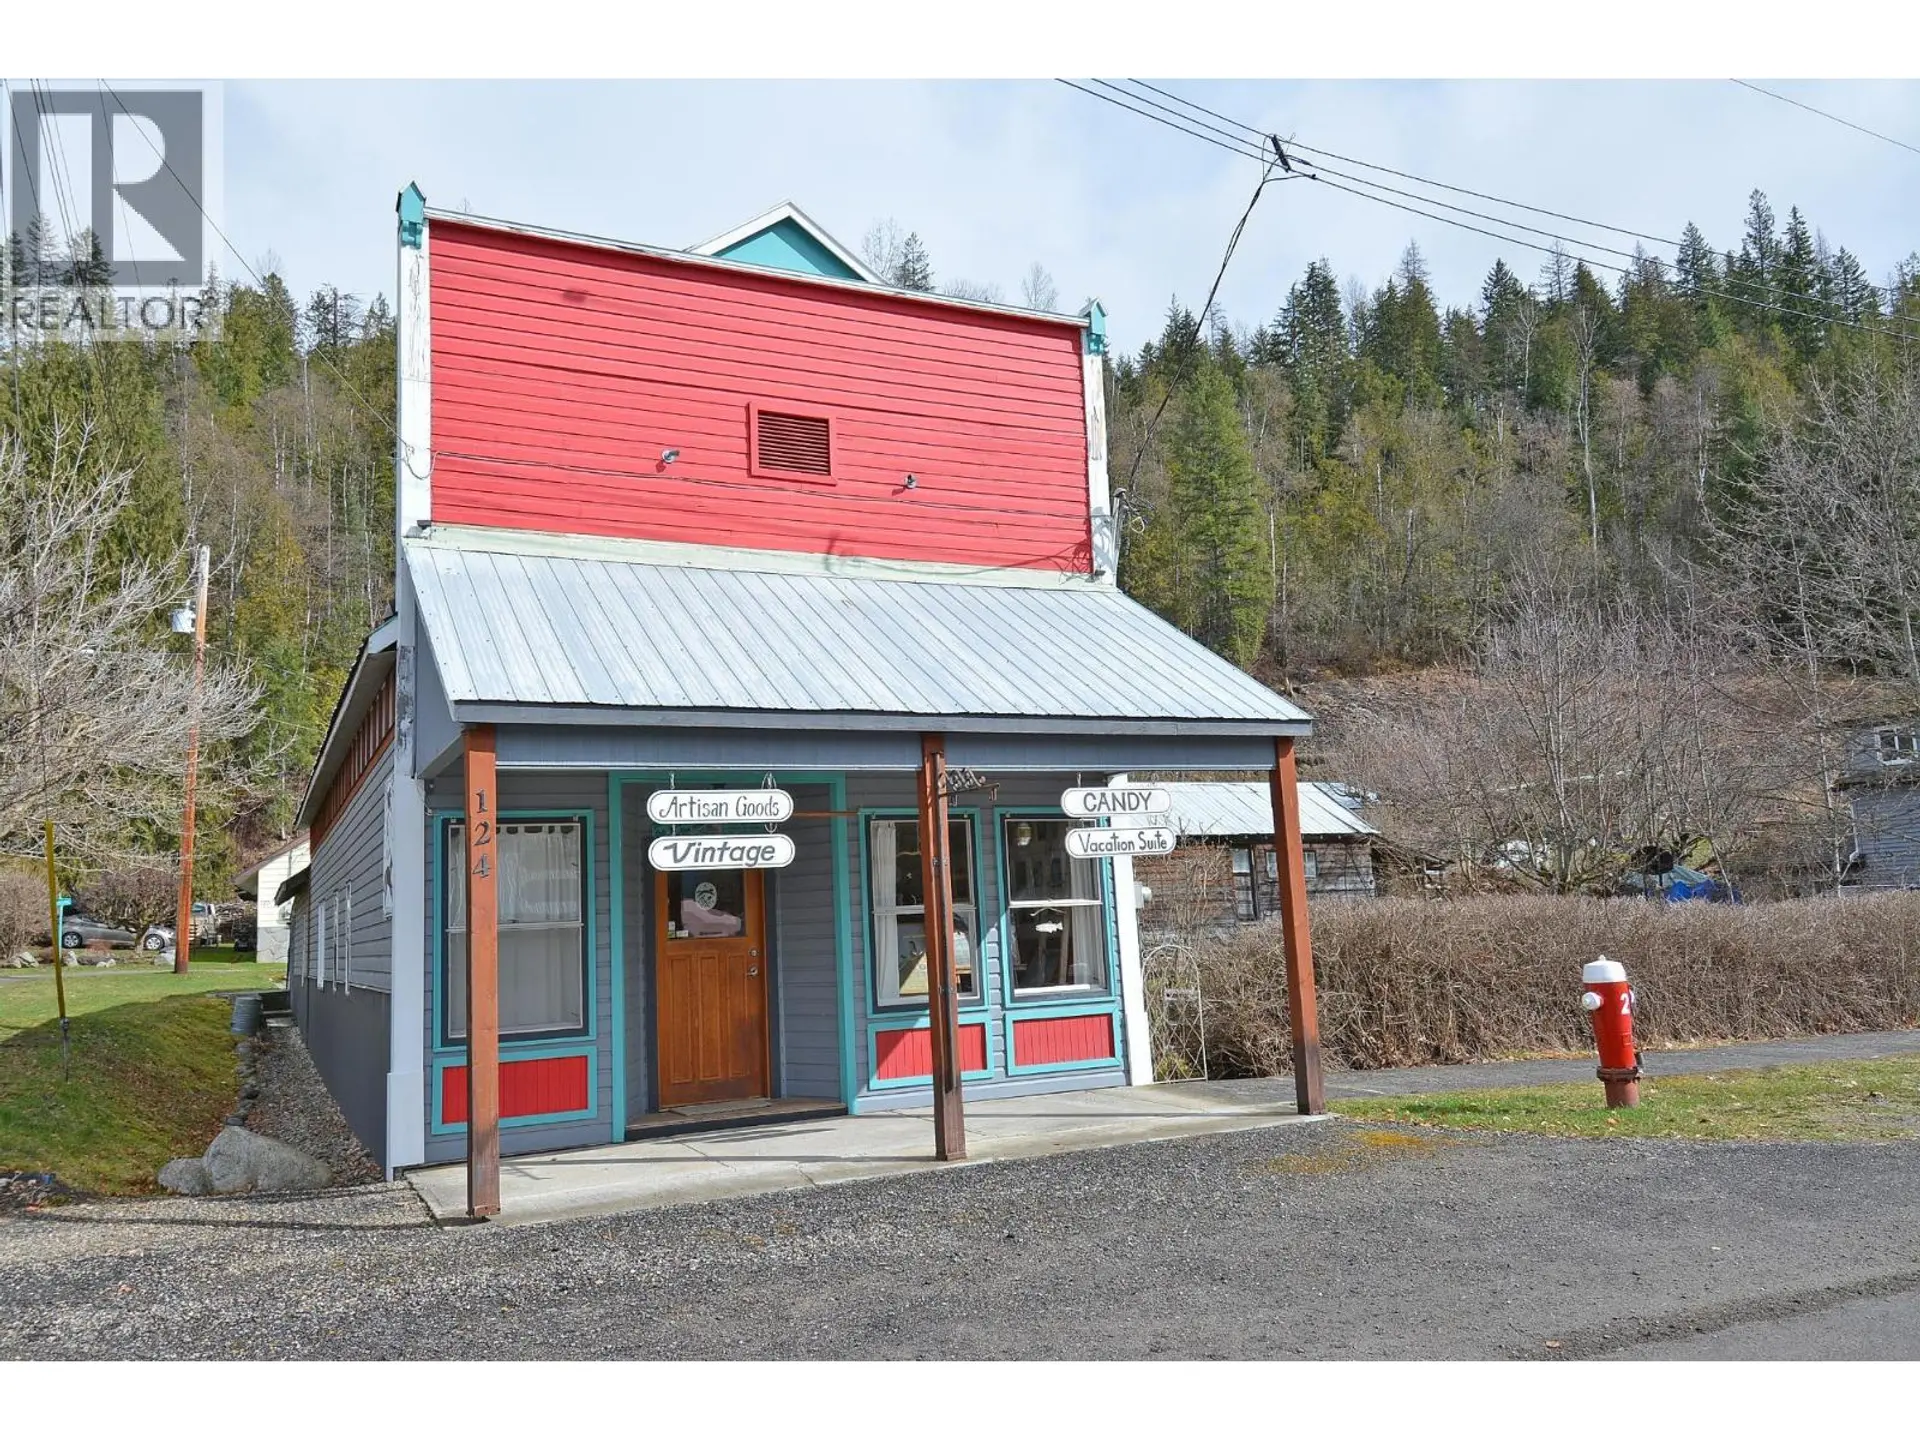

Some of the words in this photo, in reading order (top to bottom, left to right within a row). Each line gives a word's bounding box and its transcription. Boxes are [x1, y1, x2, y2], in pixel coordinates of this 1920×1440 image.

[659, 796, 728, 818] Artisan
[735, 795, 780, 817] Goods
[1083, 791, 1152, 812] CANDY
[472, 788, 492, 878] 124
[1078, 832, 1135, 853] Vacation
[1138, 830, 1167, 850] Suite
[663, 841, 776, 867] Vintage
